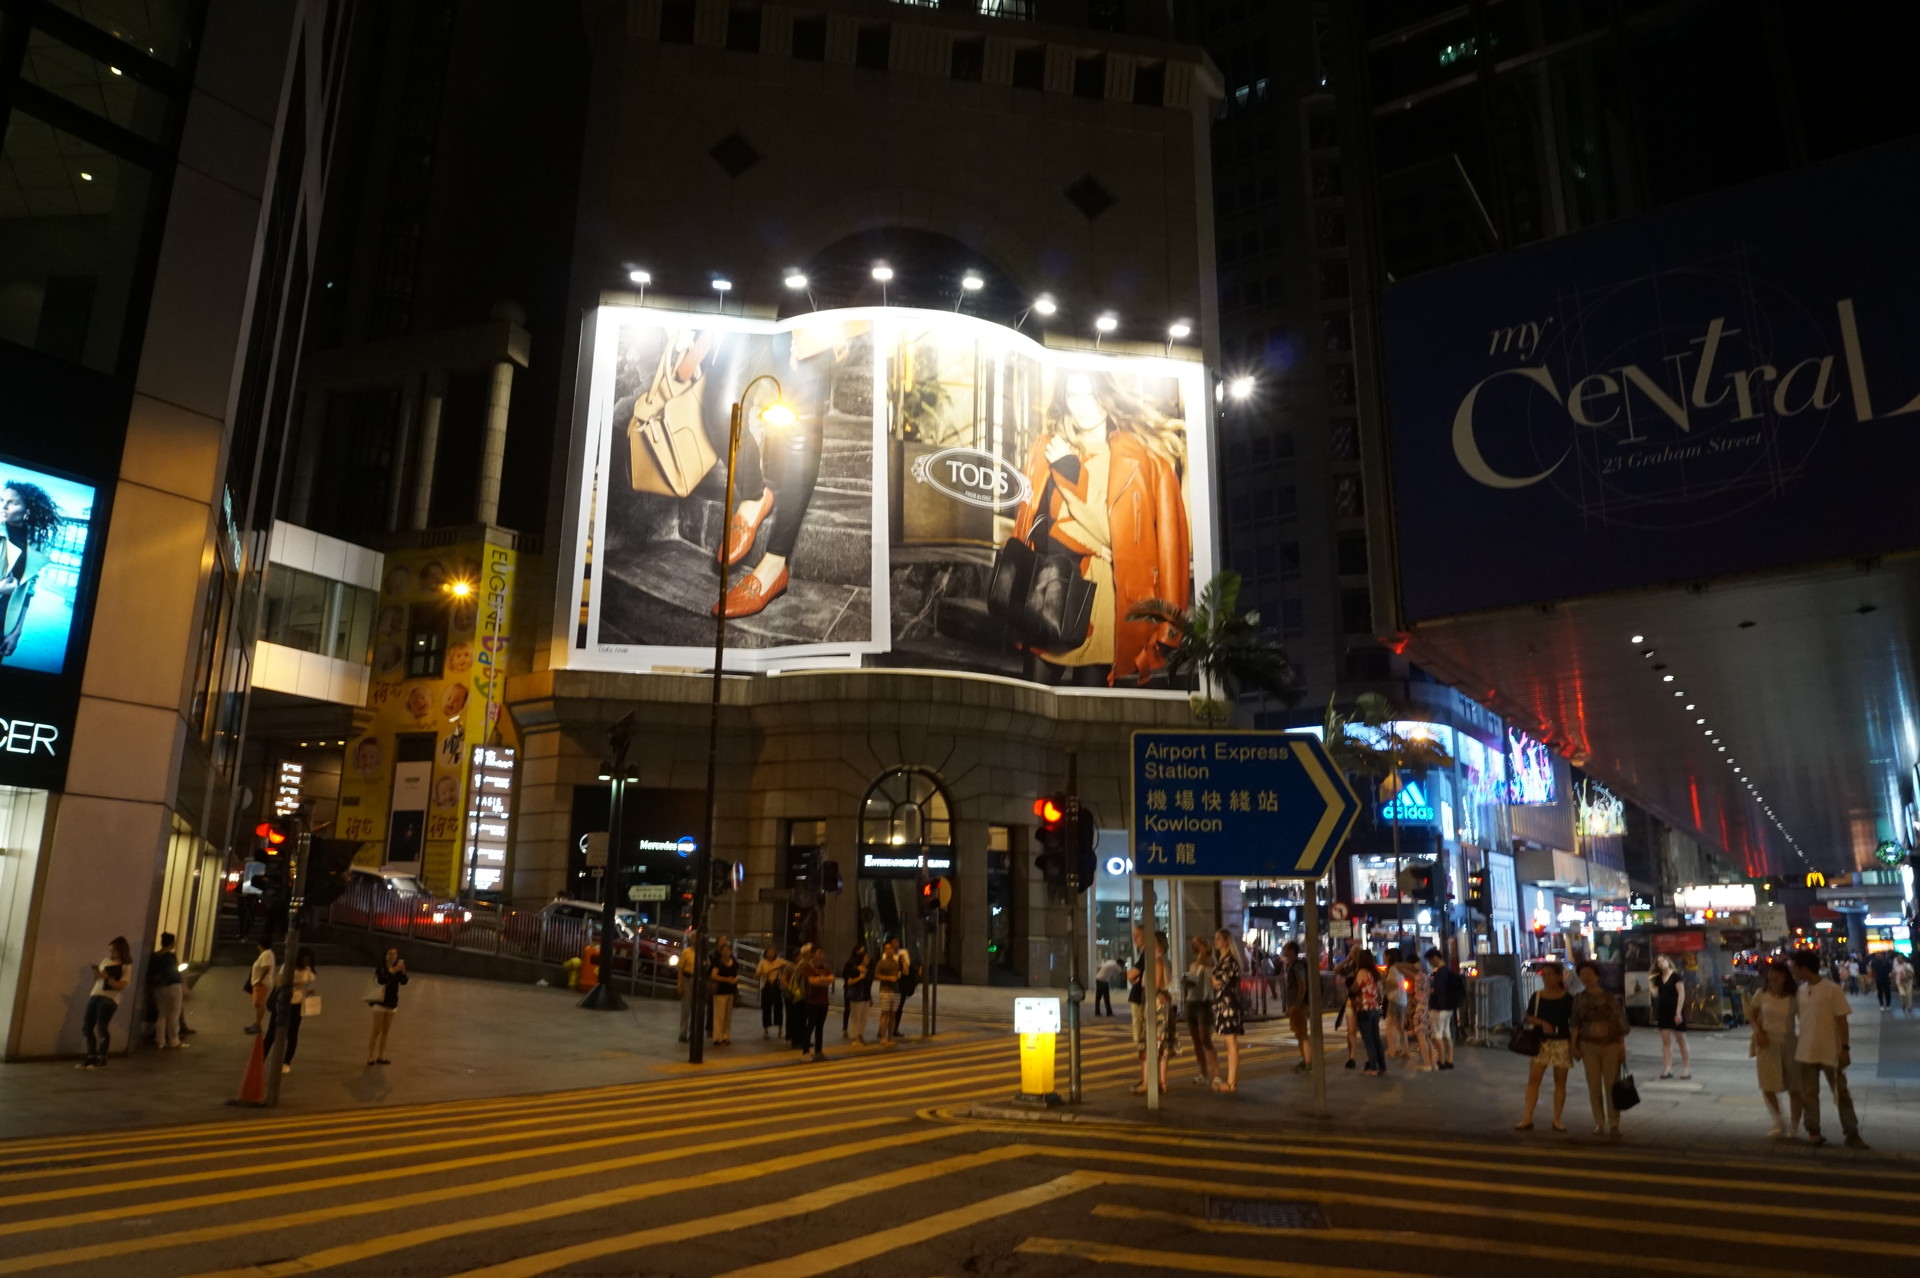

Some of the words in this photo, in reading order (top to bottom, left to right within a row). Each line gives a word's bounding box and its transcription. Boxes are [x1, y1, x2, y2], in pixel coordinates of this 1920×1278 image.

[1488, 316, 1554, 361] my
[1602, 456, 1624, 474] 23
[1627, 442, 1702, 469] Graham
[1707, 431, 1763, 456] Street
[1145, 742, 1207, 763] Airport
[1215, 742, 1289, 763] Express
[1144, 762, 1210, 780] Station
[1383, 800, 1434, 820] adidas
[1144, 814, 1223, 832] Kowloon
[1147, 841, 1197, 865] 九龍
